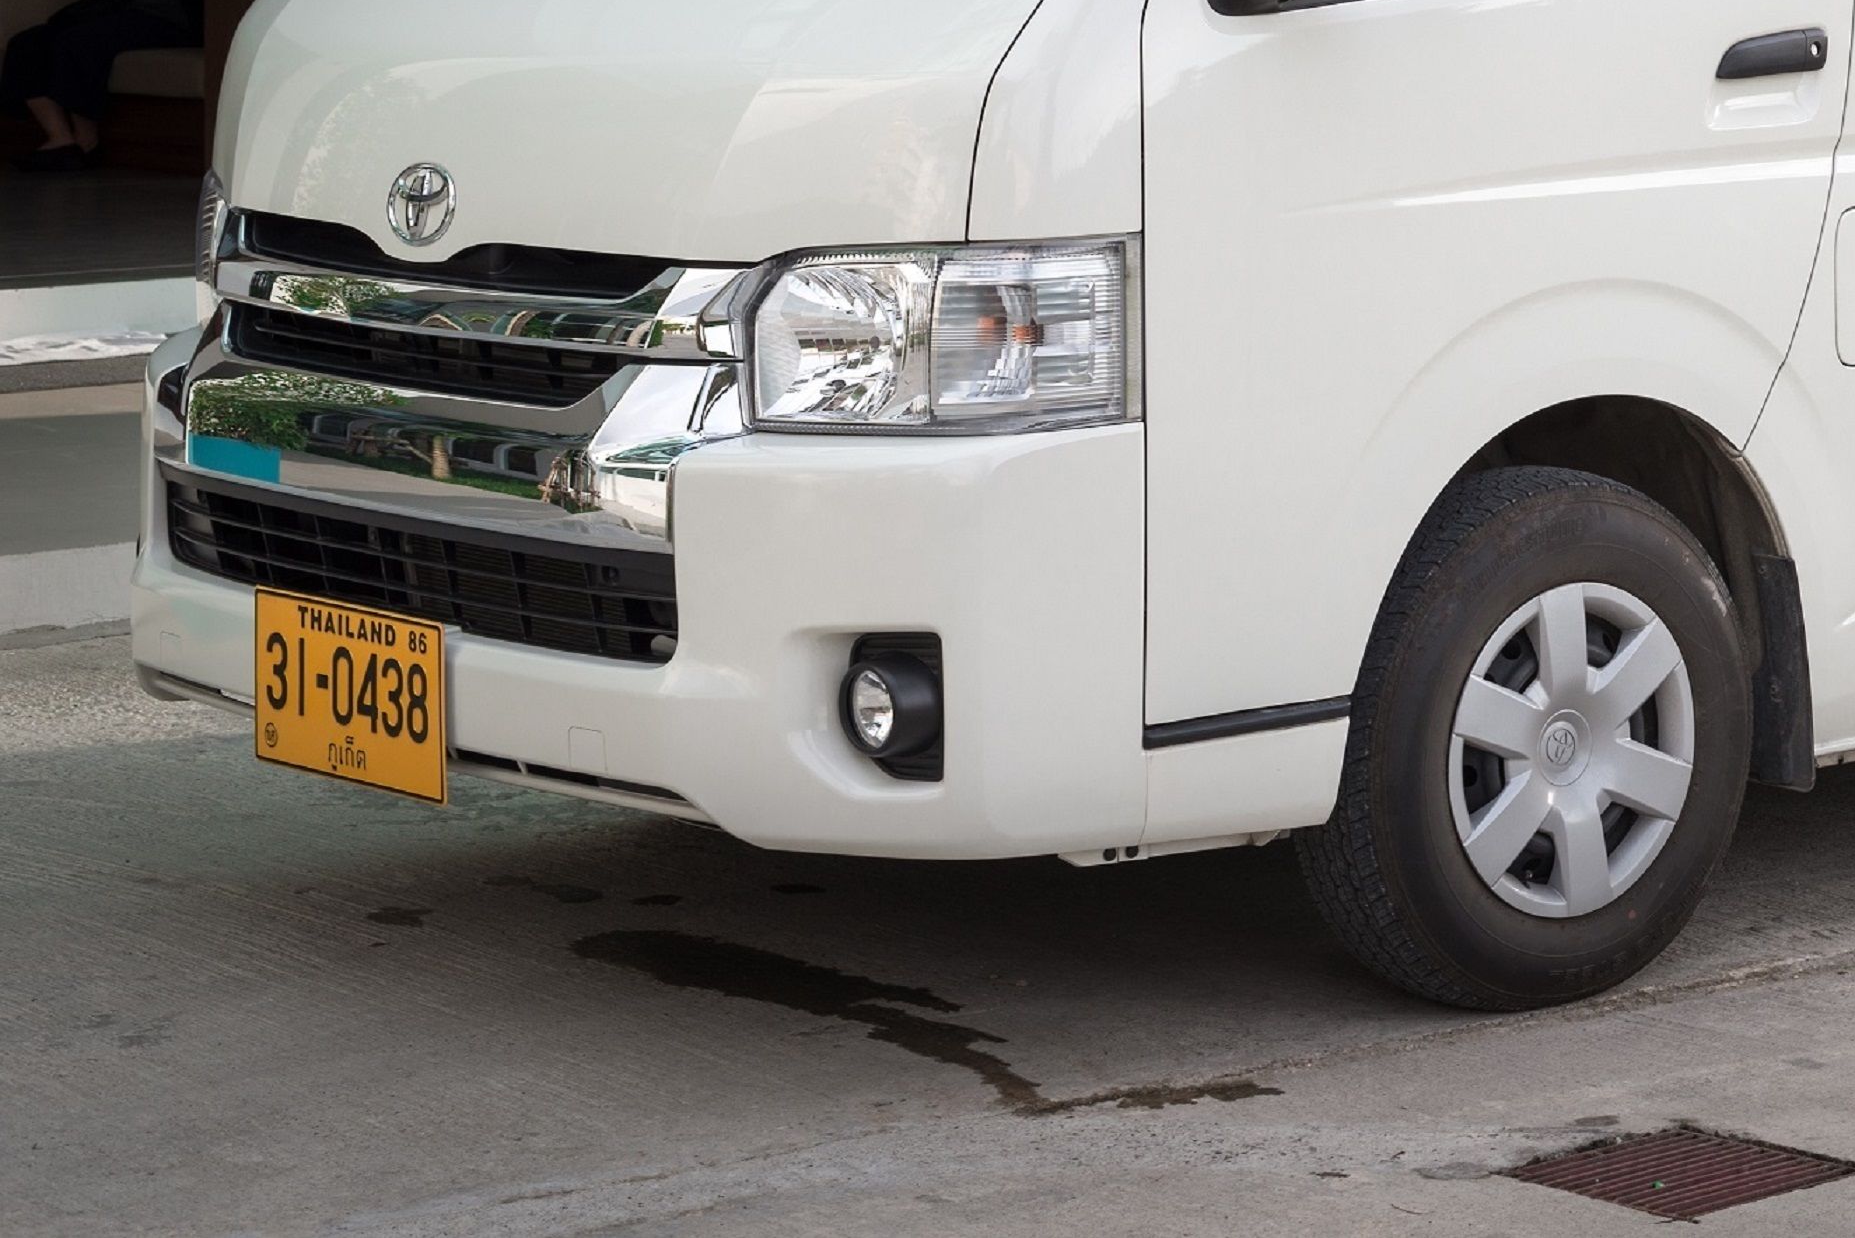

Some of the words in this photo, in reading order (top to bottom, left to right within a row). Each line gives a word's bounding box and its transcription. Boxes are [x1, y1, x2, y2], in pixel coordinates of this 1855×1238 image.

[297, 604, 397, 647] THAILAND
[407, 630, 428, 655] 86
[265, 631, 429, 744] 31-0438
